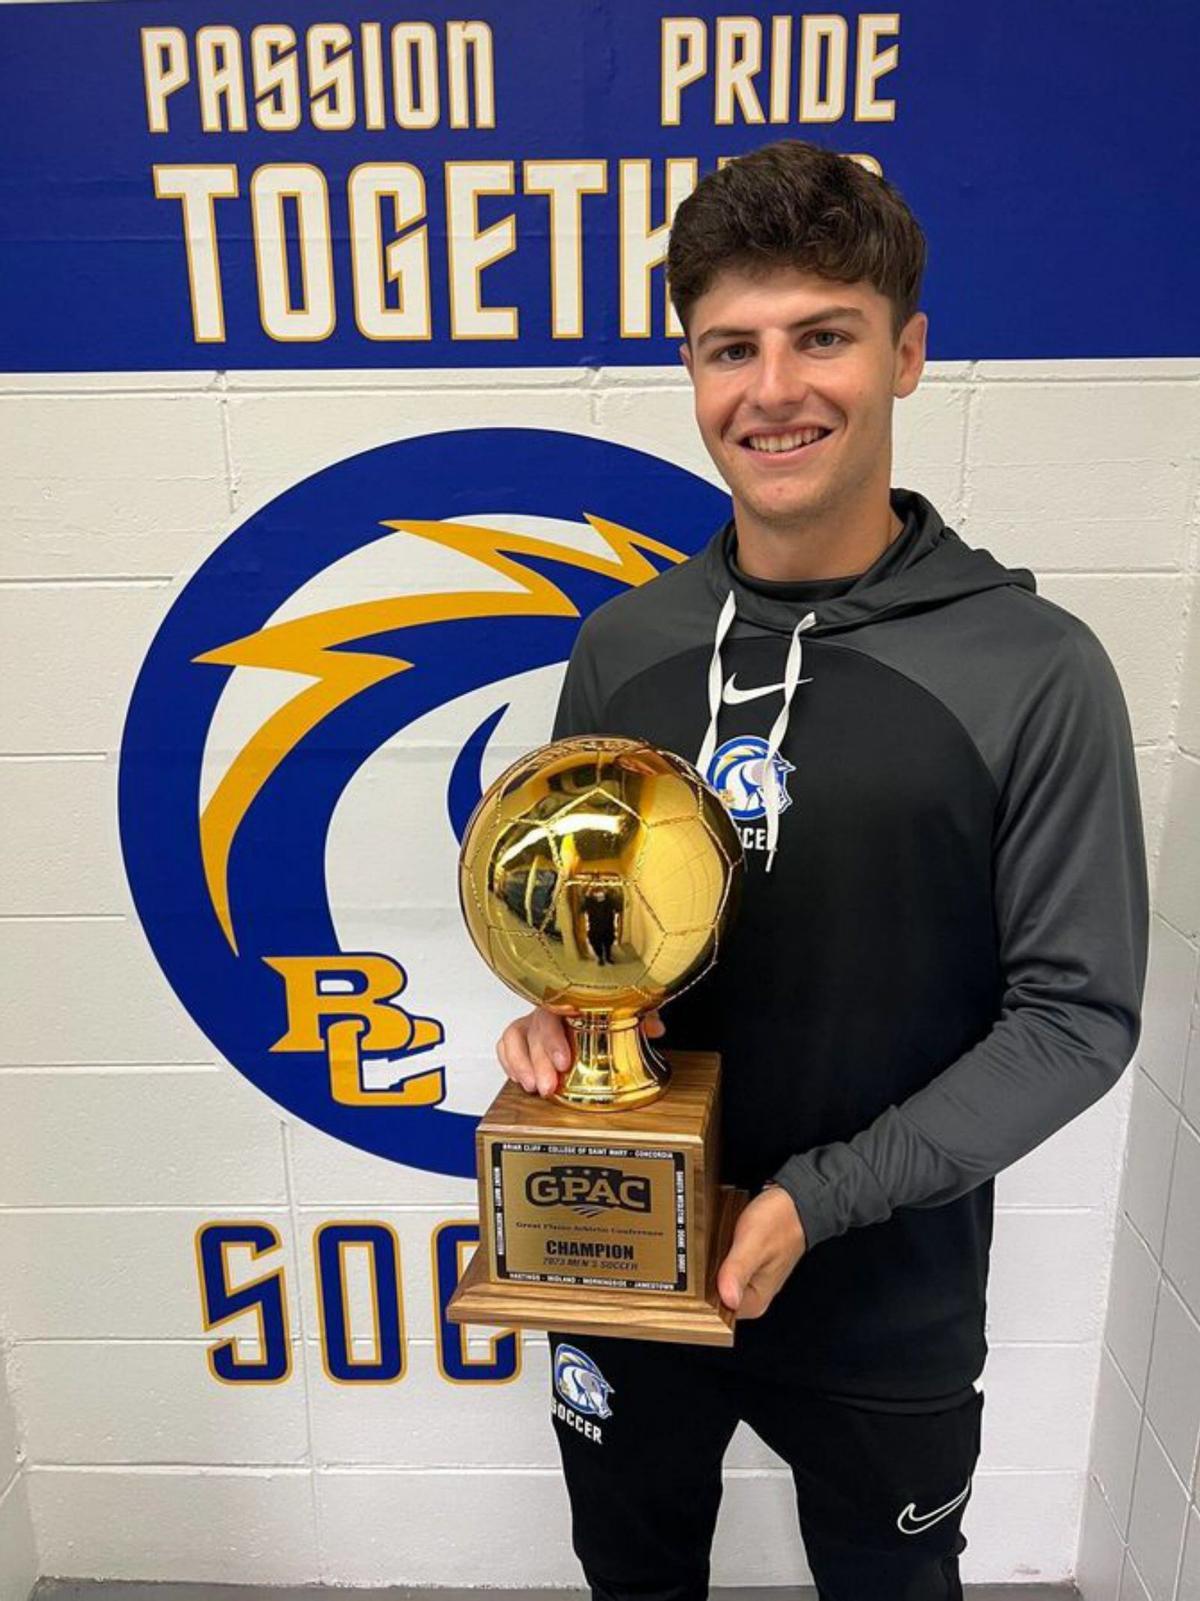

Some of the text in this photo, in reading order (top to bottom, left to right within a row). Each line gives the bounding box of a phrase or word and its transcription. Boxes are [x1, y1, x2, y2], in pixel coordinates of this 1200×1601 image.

[140, 12, 900, 133] PASSION PRIDE
[152, 156, 883, 343] TOGETH
[530, 1175, 646, 1209] GPAC
[546, 1239, 634, 1261] CHAMPION
